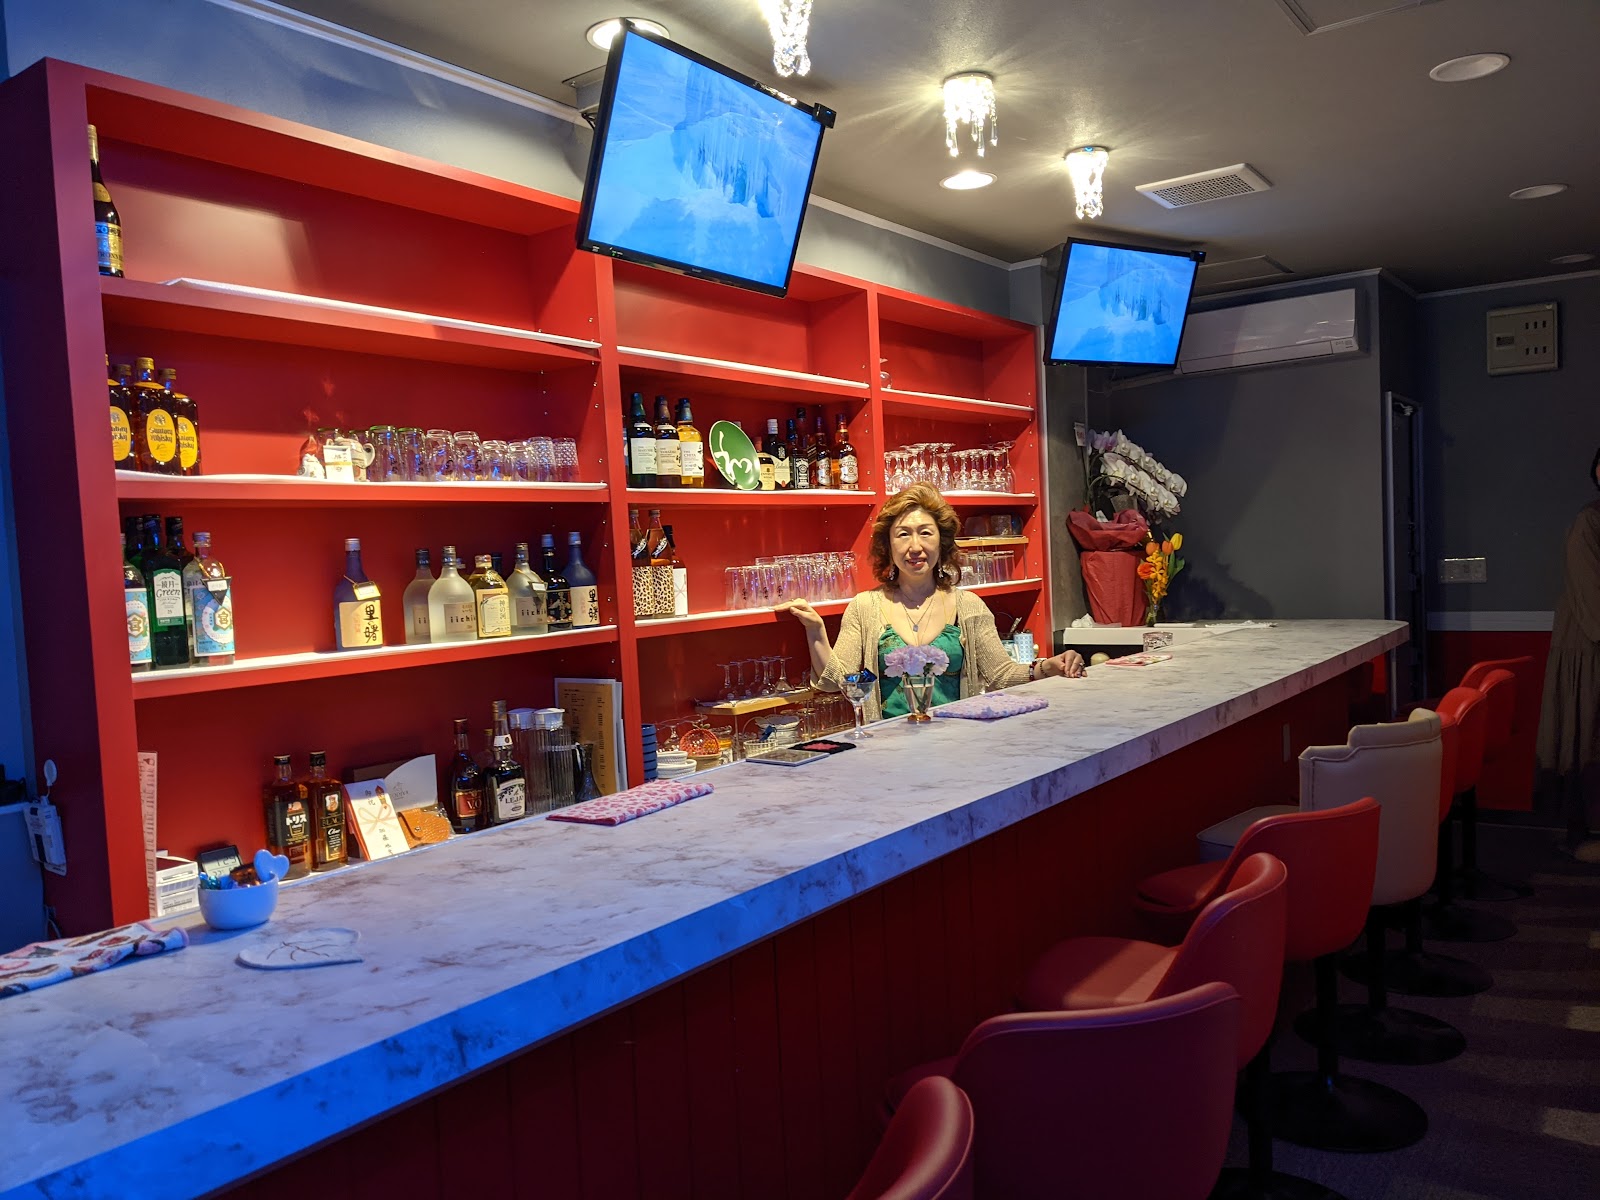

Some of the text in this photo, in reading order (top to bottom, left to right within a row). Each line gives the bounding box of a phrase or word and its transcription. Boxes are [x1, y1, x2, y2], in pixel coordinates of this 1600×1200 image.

[149, 427, 173, 436] Suntory
[150, 434, 173, 443] Whisky
[156, 588, 181, 599] Green
[286, 814, 307, 826] トリス
